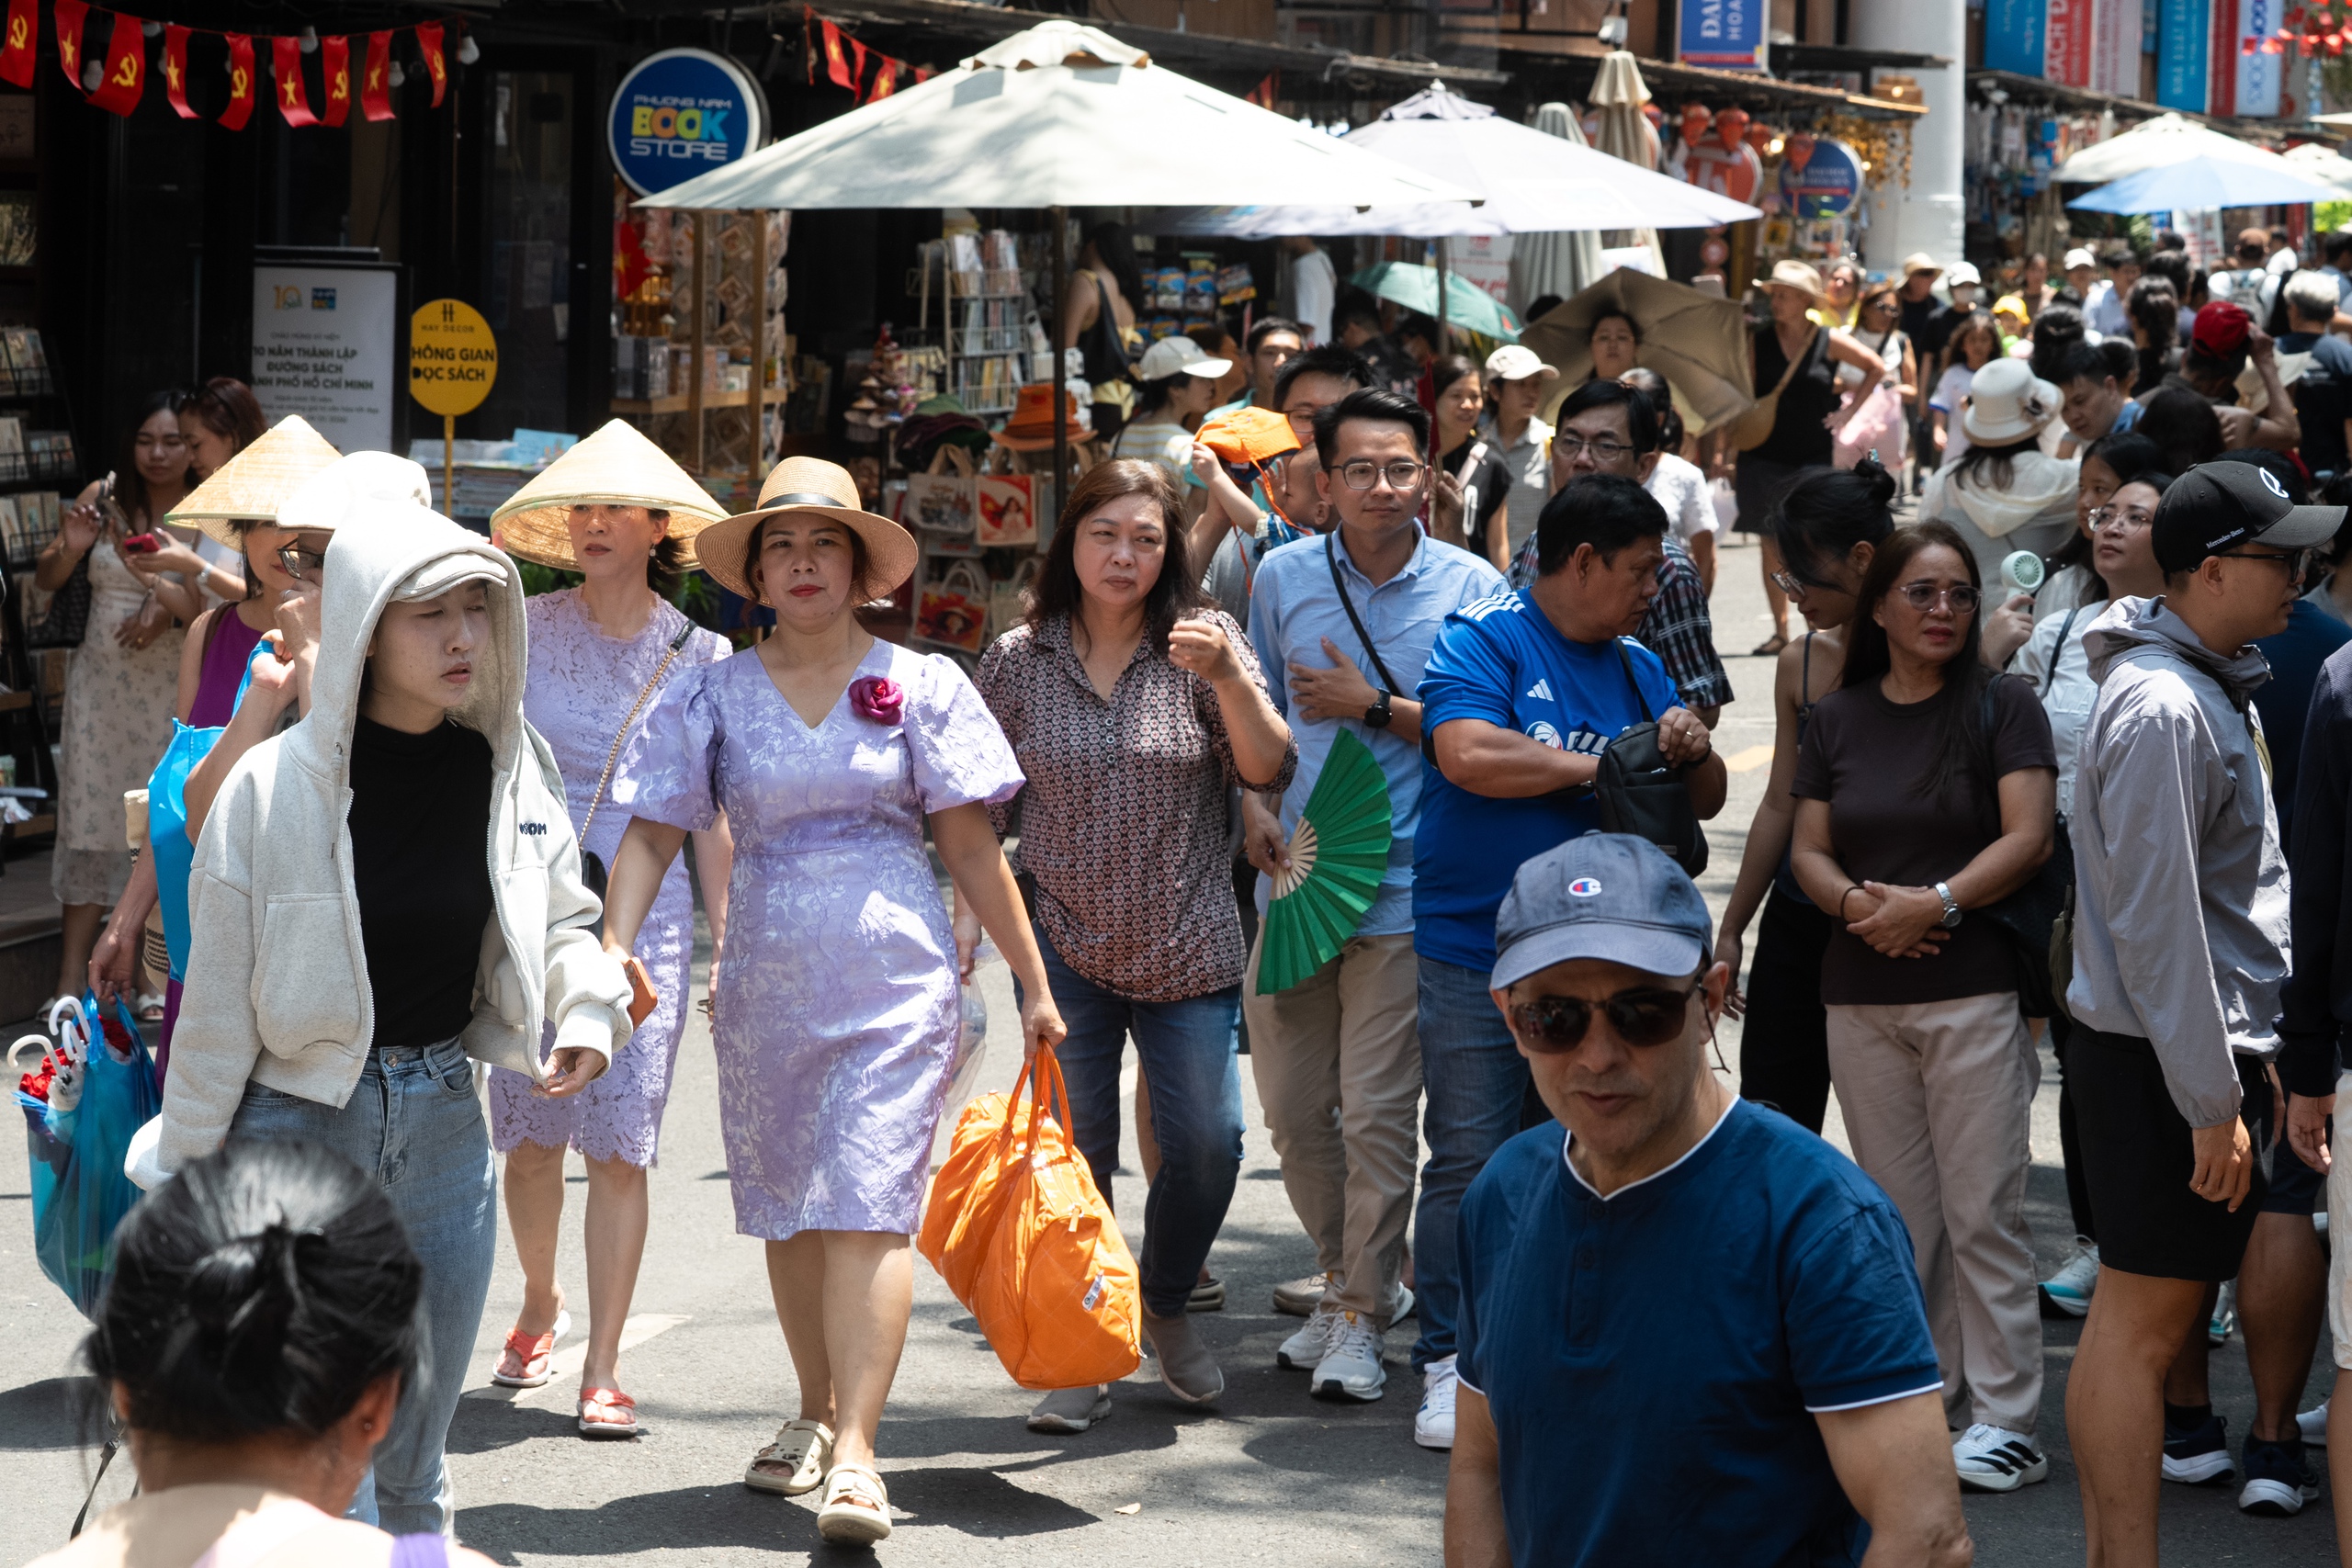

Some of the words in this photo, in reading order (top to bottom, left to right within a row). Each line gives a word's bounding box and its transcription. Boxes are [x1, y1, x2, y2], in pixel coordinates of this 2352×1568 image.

[698, 97, 732, 109] NAM
[631, 105, 729, 142] BOOK
[629, 138, 729, 161] STORE
[411, 344, 456, 361] HÔNG
[459, 347, 495, 362] GIAN
[447, 364, 486, 381] SÁCH
[2206, 527, 2245, 549] Mercedes-Benz
